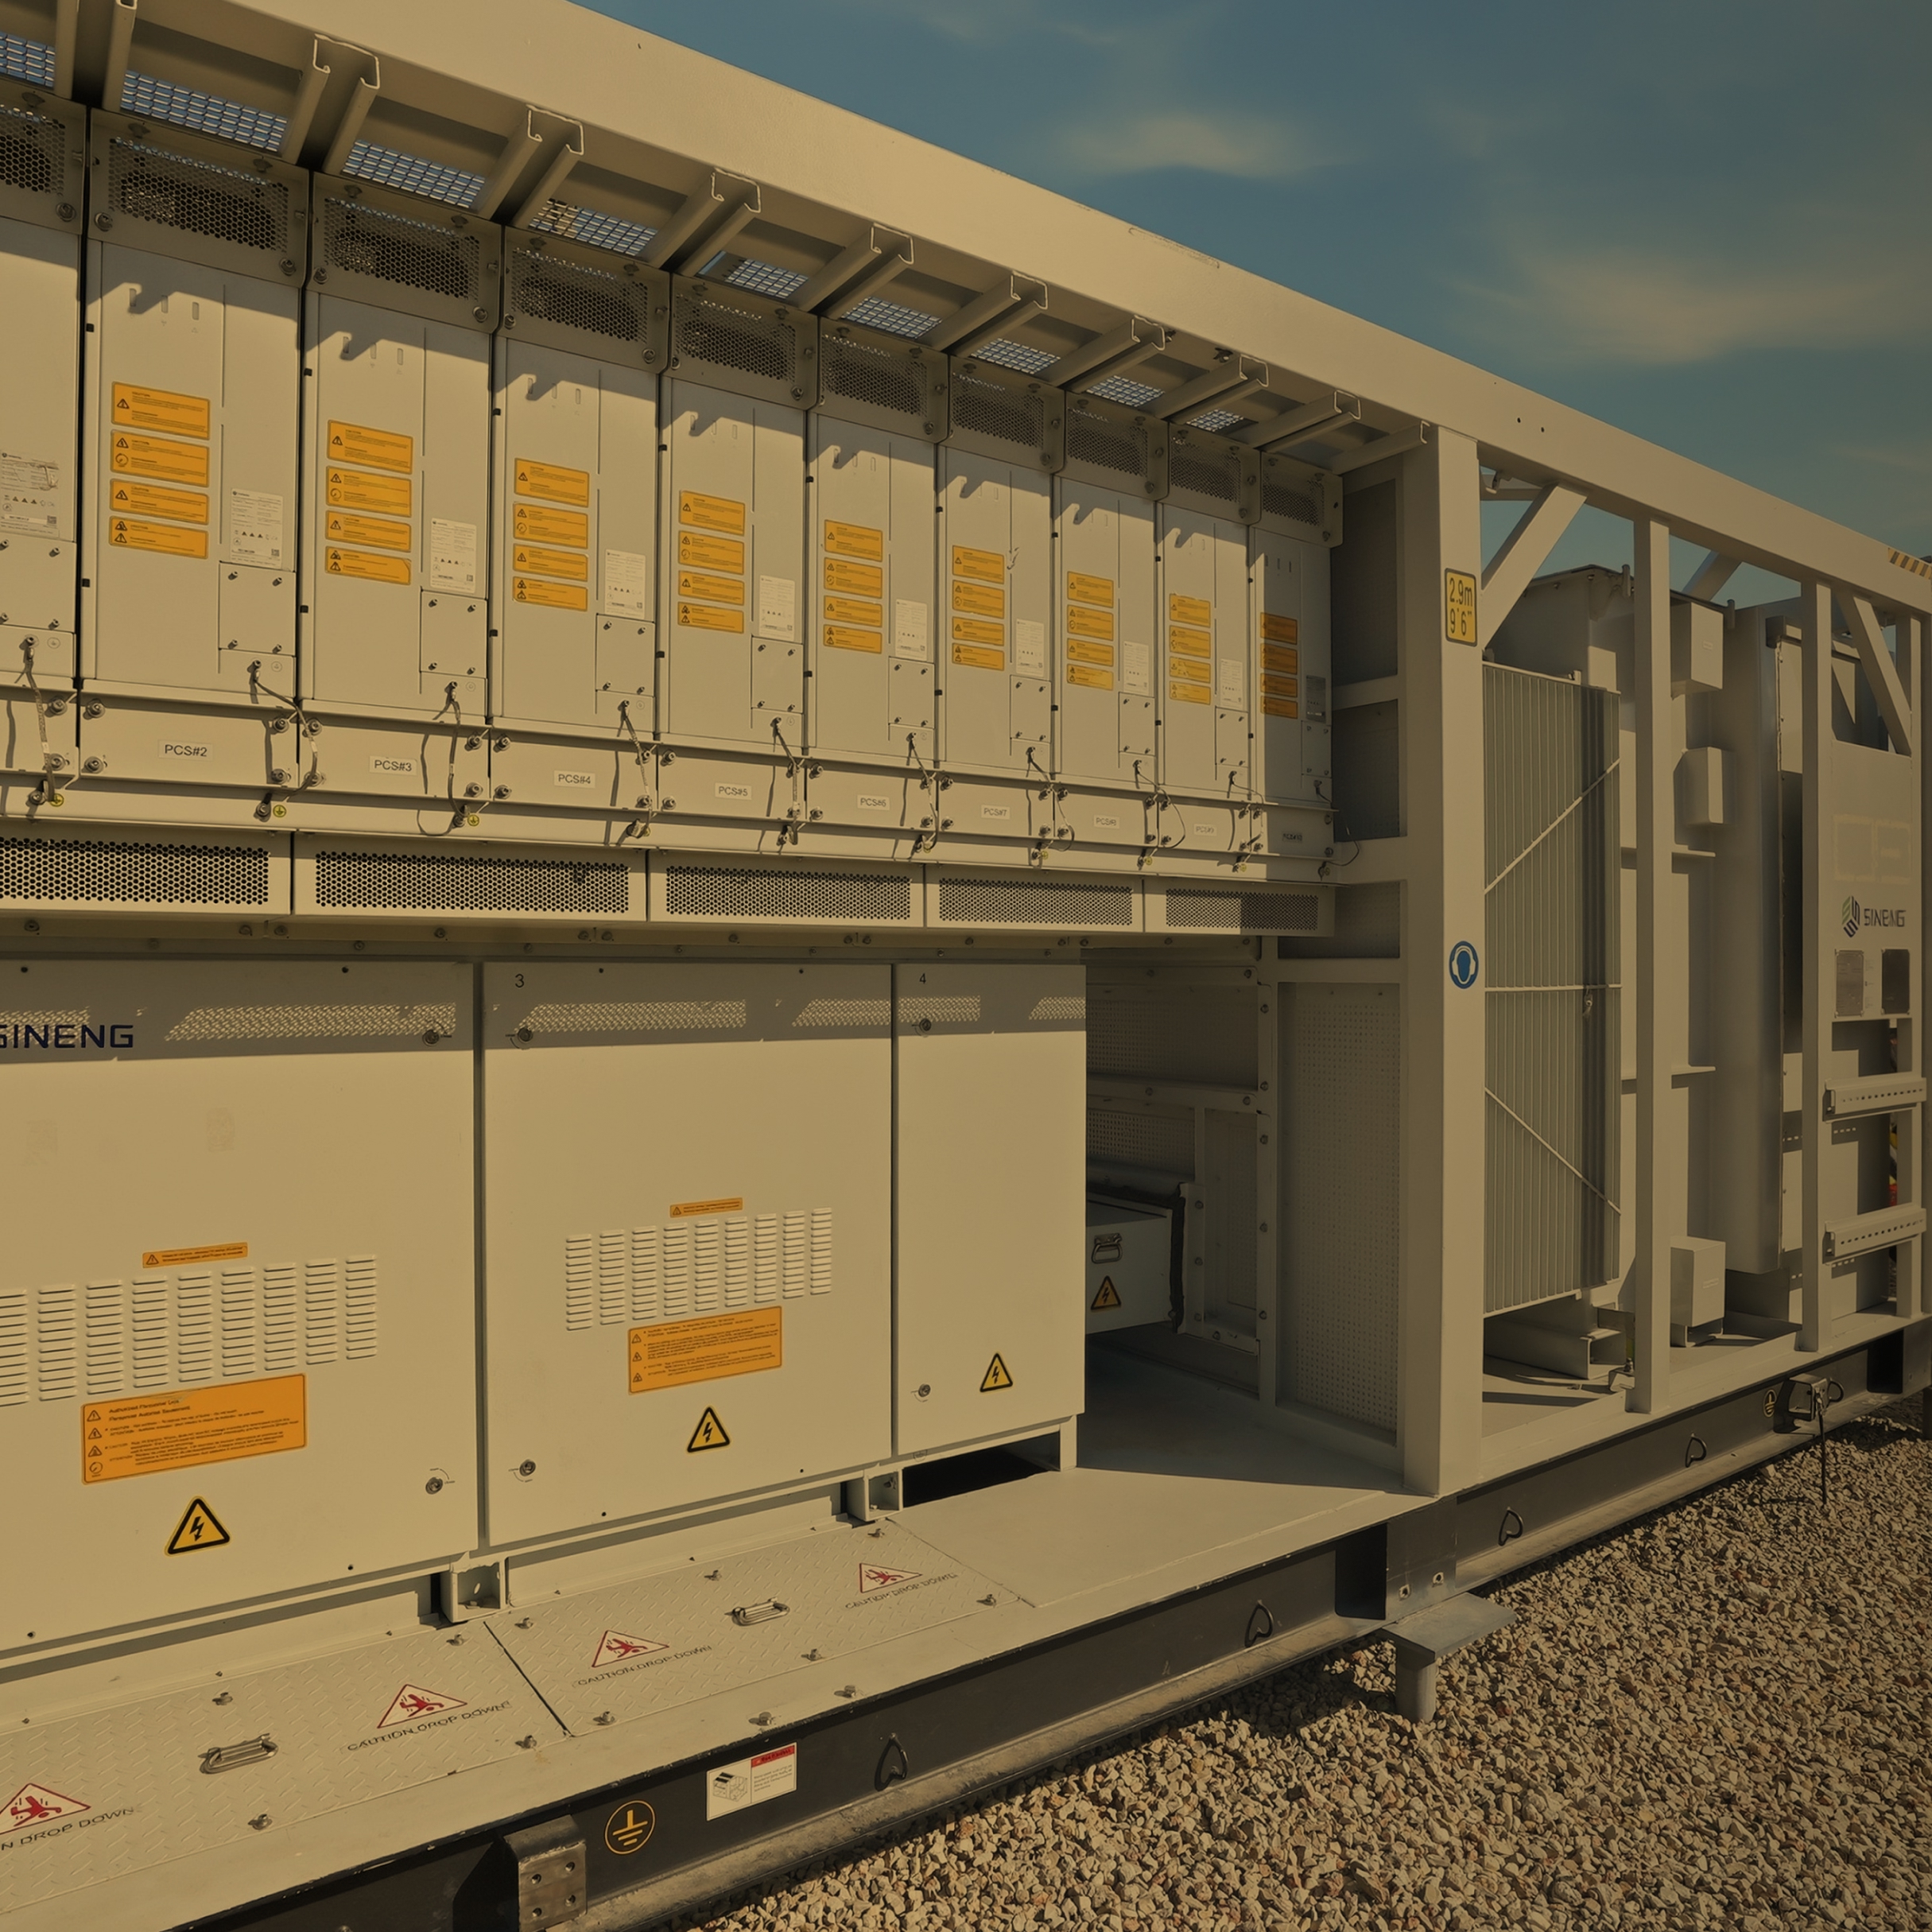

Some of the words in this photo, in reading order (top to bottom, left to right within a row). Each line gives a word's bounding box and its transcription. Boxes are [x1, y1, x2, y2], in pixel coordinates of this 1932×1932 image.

[1449, 577, 1472, 607] 2.9m
[164, 743, 208, 757] PCS#2
[374, 759, 413, 772] PCS#3
[557, 774, 592, 785] PCS#4
[718, 786, 748, 797] PCS#5
[859, 797, 886, 808] PCS#6
[983, 807, 1007, 817] PCS#7
[1864, 909, 1907, 927] SINENG
[514, 973, 525, 988] 3
[919, 972, 926, 984] 4
[845, 1592, 891, 1609] CAUTION
[892, 1583, 920, 1596] DROP
[577, 1666, 635, 1686] CAUTION
[636, 1655, 673, 1670] DROP
[673, 1644, 713, 1660] DOWN
[347, 1728, 413, 1752] CAUTION
[417, 1715, 457, 1732] DROP
[20, 1823, 73, 1845] DROP
[79, 1806, 134, 1828] DOWN
